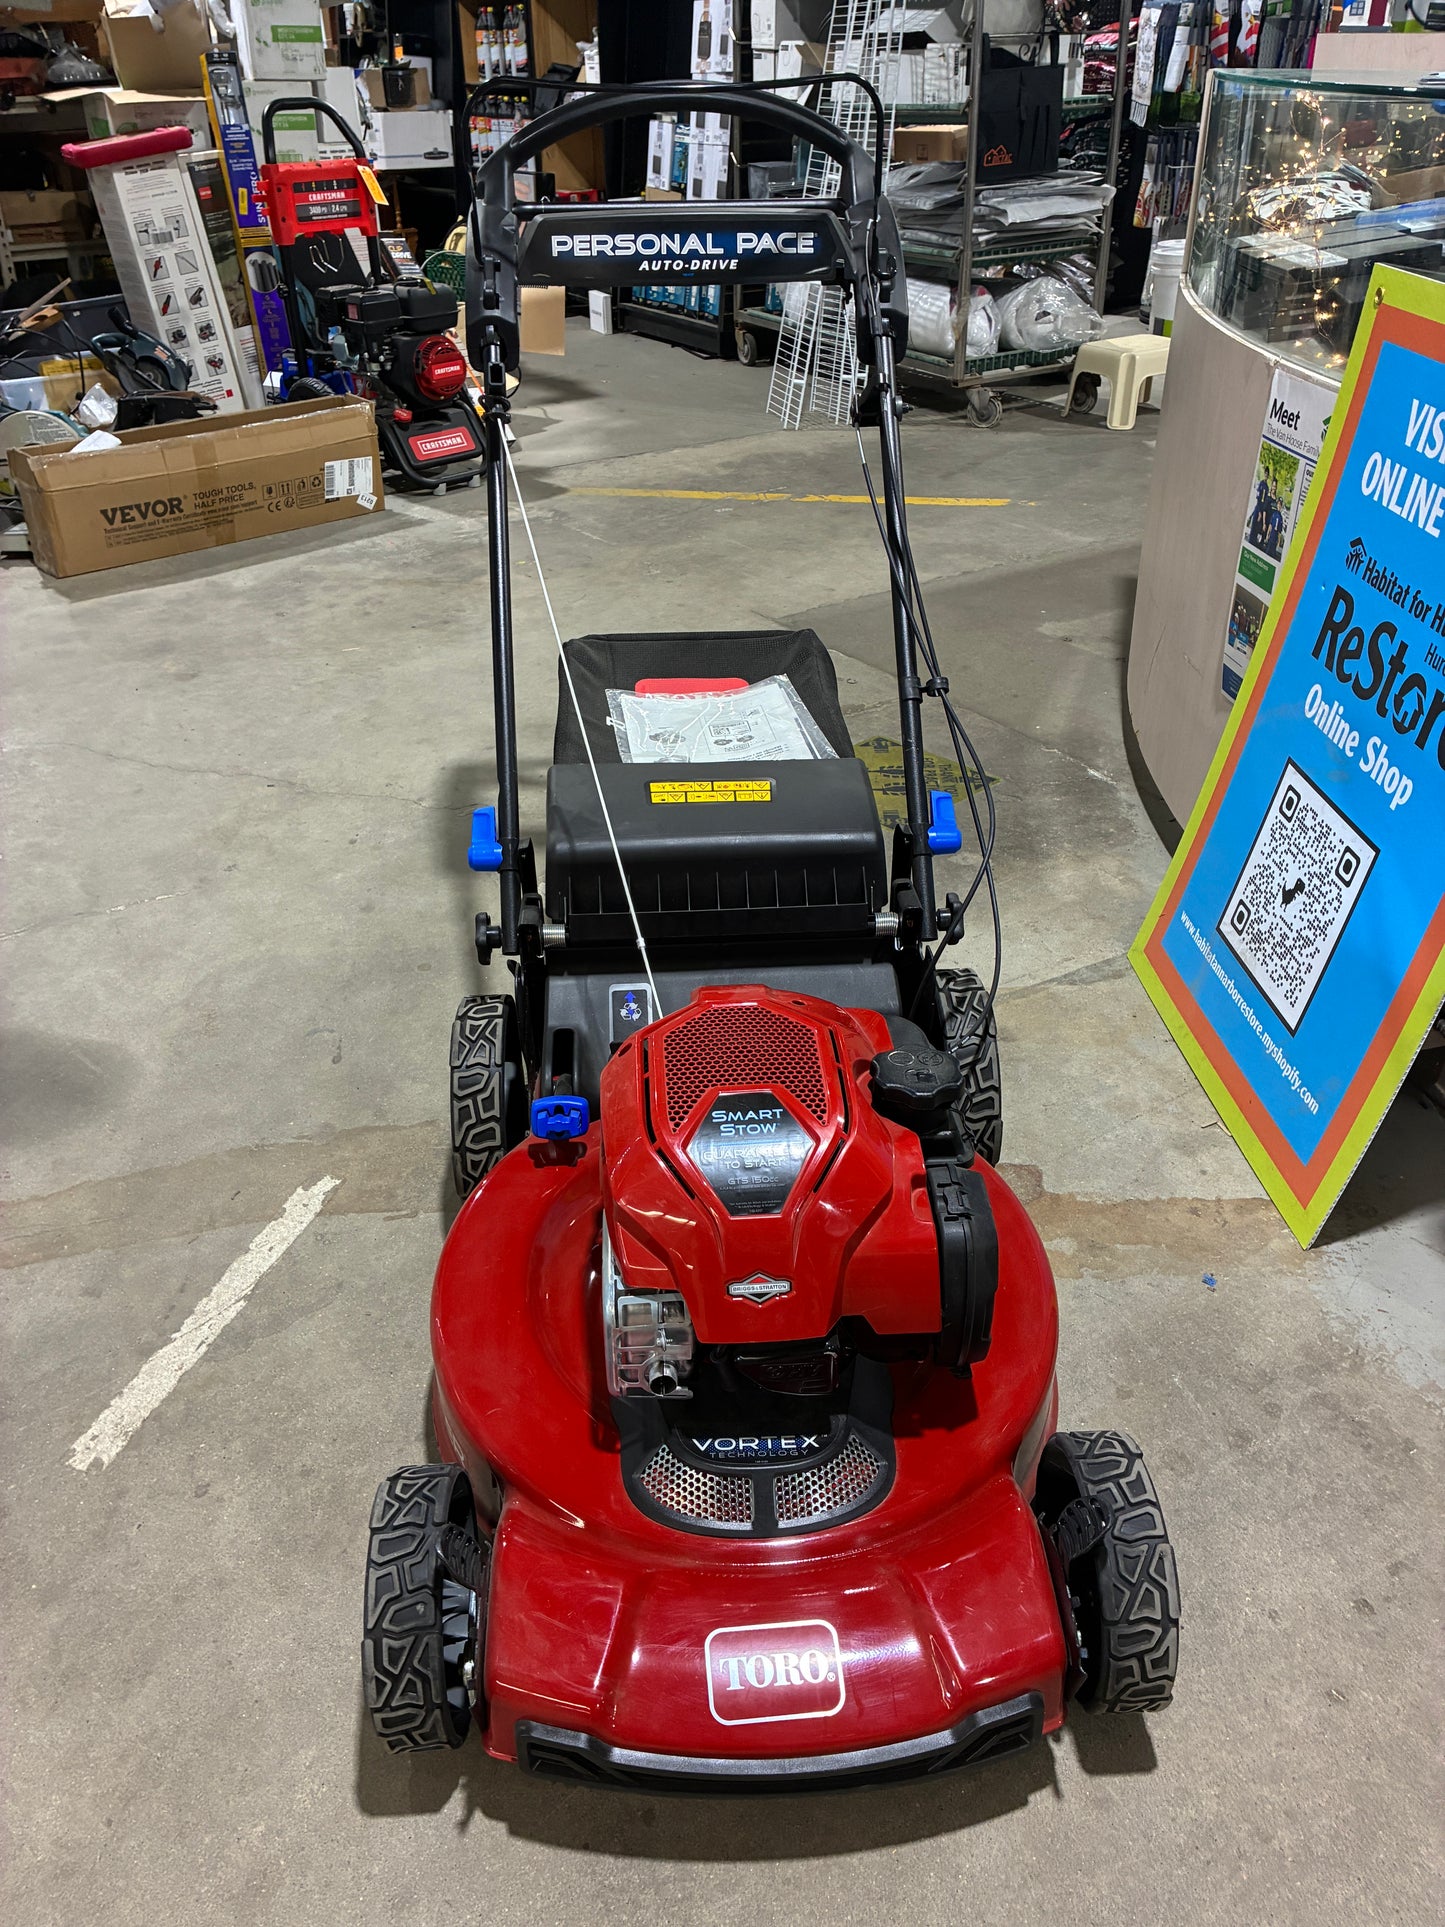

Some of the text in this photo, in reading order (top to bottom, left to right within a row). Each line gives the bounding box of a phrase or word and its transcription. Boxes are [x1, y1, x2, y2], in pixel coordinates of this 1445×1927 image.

[308, 191, 346, 202] CRAFTSMAN
[551, 232, 815, 257] PERSONAL PACE
[638, 259, 739, 271] AUTO-DRIVE
[434, 364, 461, 375] CRAFTSMAN
[1269, 398, 1301, 431] Meet
[1275, 427, 1286, 441] Van
[421, 436, 463, 451] CRAFTSMAN
[193, 493, 245, 511] HALF PRICE
[1361, 451, 1445, 538] ONLINE
[100, 482, 257, 526] VEVOR TOUGH TOOLS,
[1361, 556, 1409, 610] Habitat
[1408, 589, 1433, 623] for
[1304, 683, 1414, 811] Online Shop
[1180, 910, 1320, 1115] www.habitatannarborrestore.myshopify.com
[711, 1108, 784, 1122] SMART
[720, 1122, 777, 1136] STOW
[724, 1161, 740, 1169] TO
[727, 1177, 749, 1185] GTS
[692, 1434, 820, 1451] VORTEX
[709, 1449, 809, 1459] TECHNOLOGY
[719, 1650, 830, 1691] TORO
